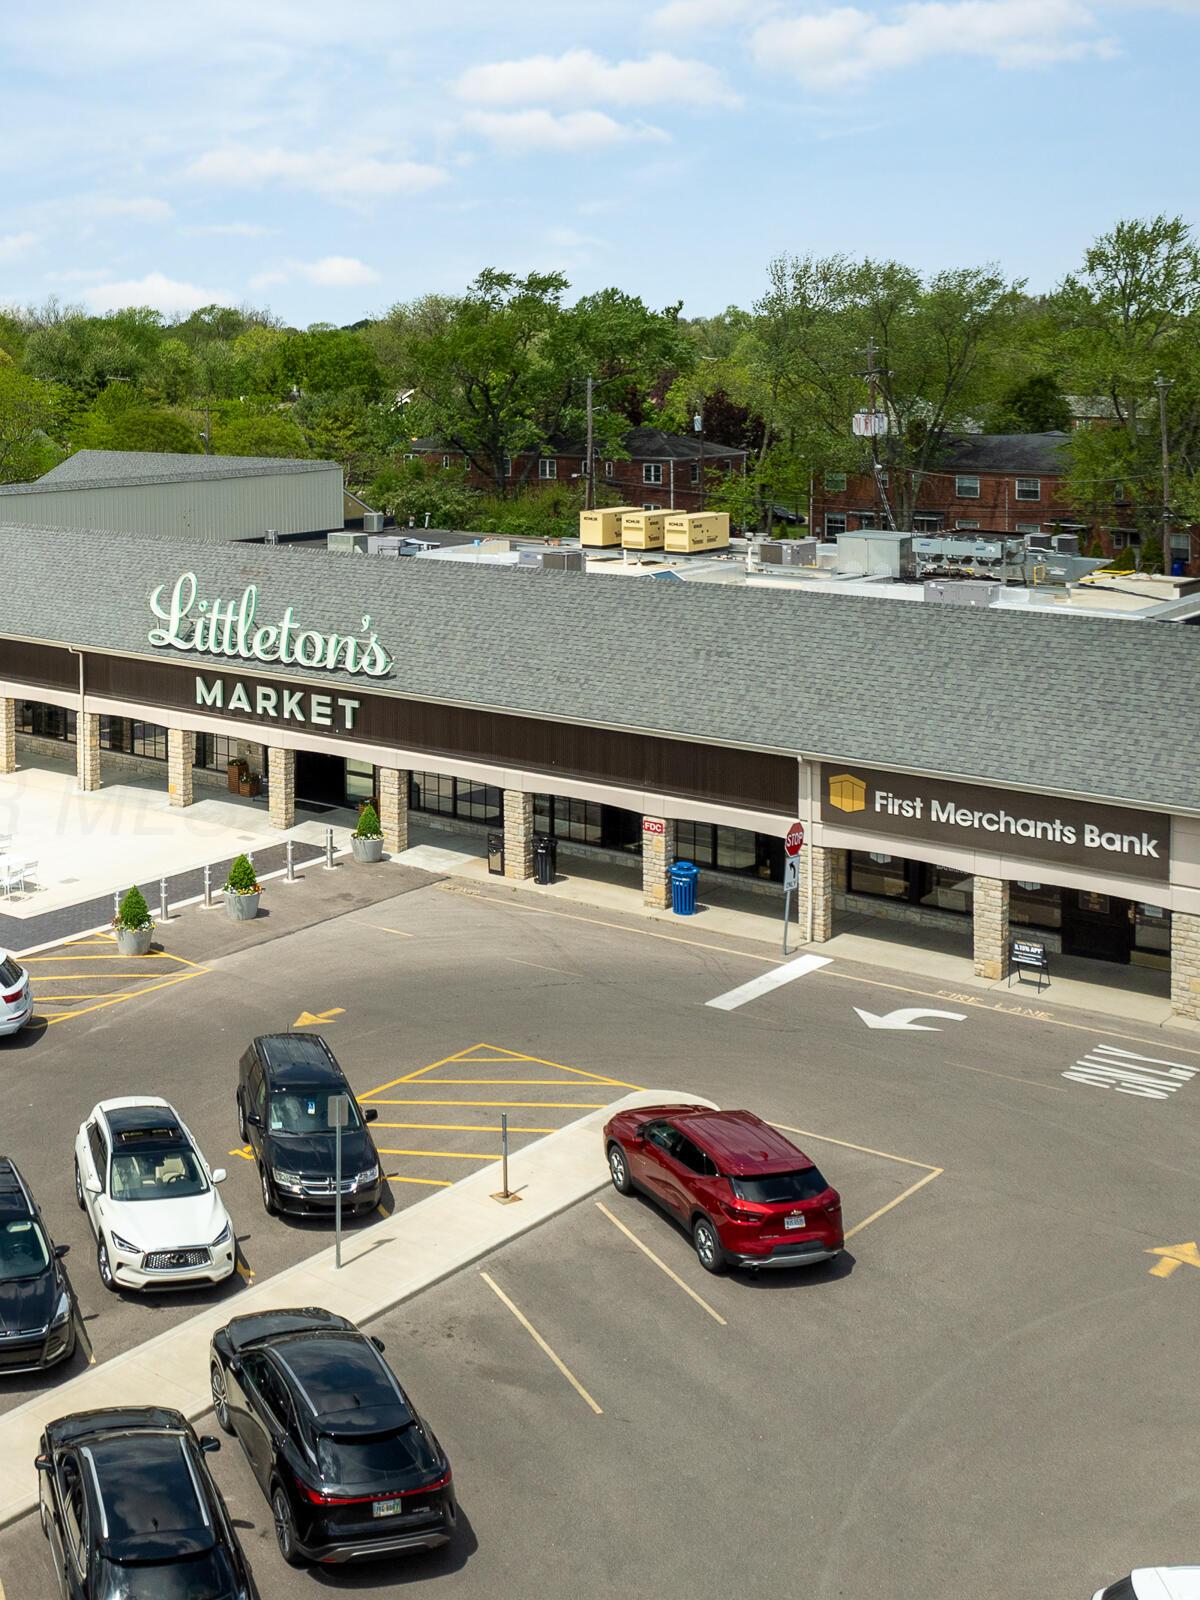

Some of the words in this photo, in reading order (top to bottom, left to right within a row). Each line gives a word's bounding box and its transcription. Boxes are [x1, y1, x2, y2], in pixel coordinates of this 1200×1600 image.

[147, 571, 395, 676] Littleton's
[195, 676, 361, 730] MARKET
[644, 821, 662, 833] FDC
[786, 832, 804, 848] STOP
[874, 790, 924, 820] First
[930, 800, 1077, 845] Merchants
[1084, 823, 1161, 859] Bank
[936, 990, 984, 1005] FIRE
[993, 1002, 1055, 1020] LANE
